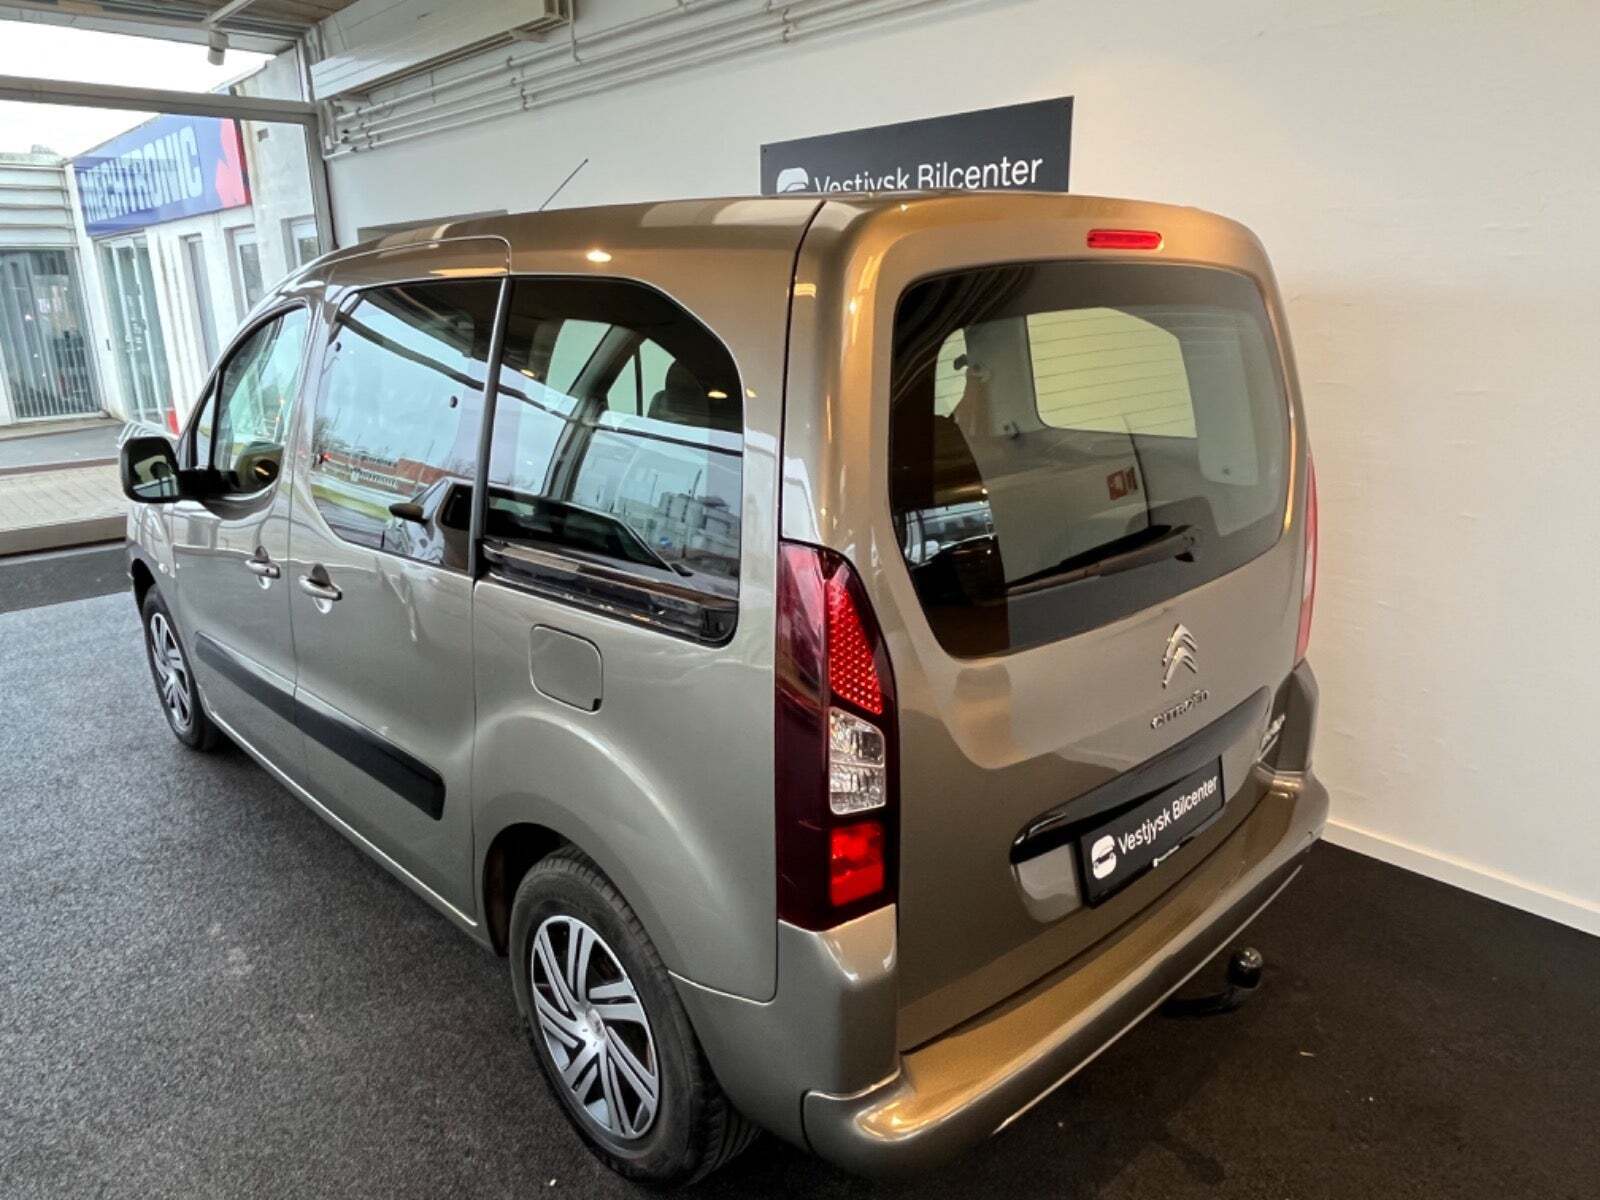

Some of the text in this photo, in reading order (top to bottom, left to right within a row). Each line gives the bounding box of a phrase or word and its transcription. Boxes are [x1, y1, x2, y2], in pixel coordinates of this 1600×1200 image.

[918, 156, 1043, 190] Bilcenter
[1117, 776, 1218, 855] Vestjysk Bilcenter
